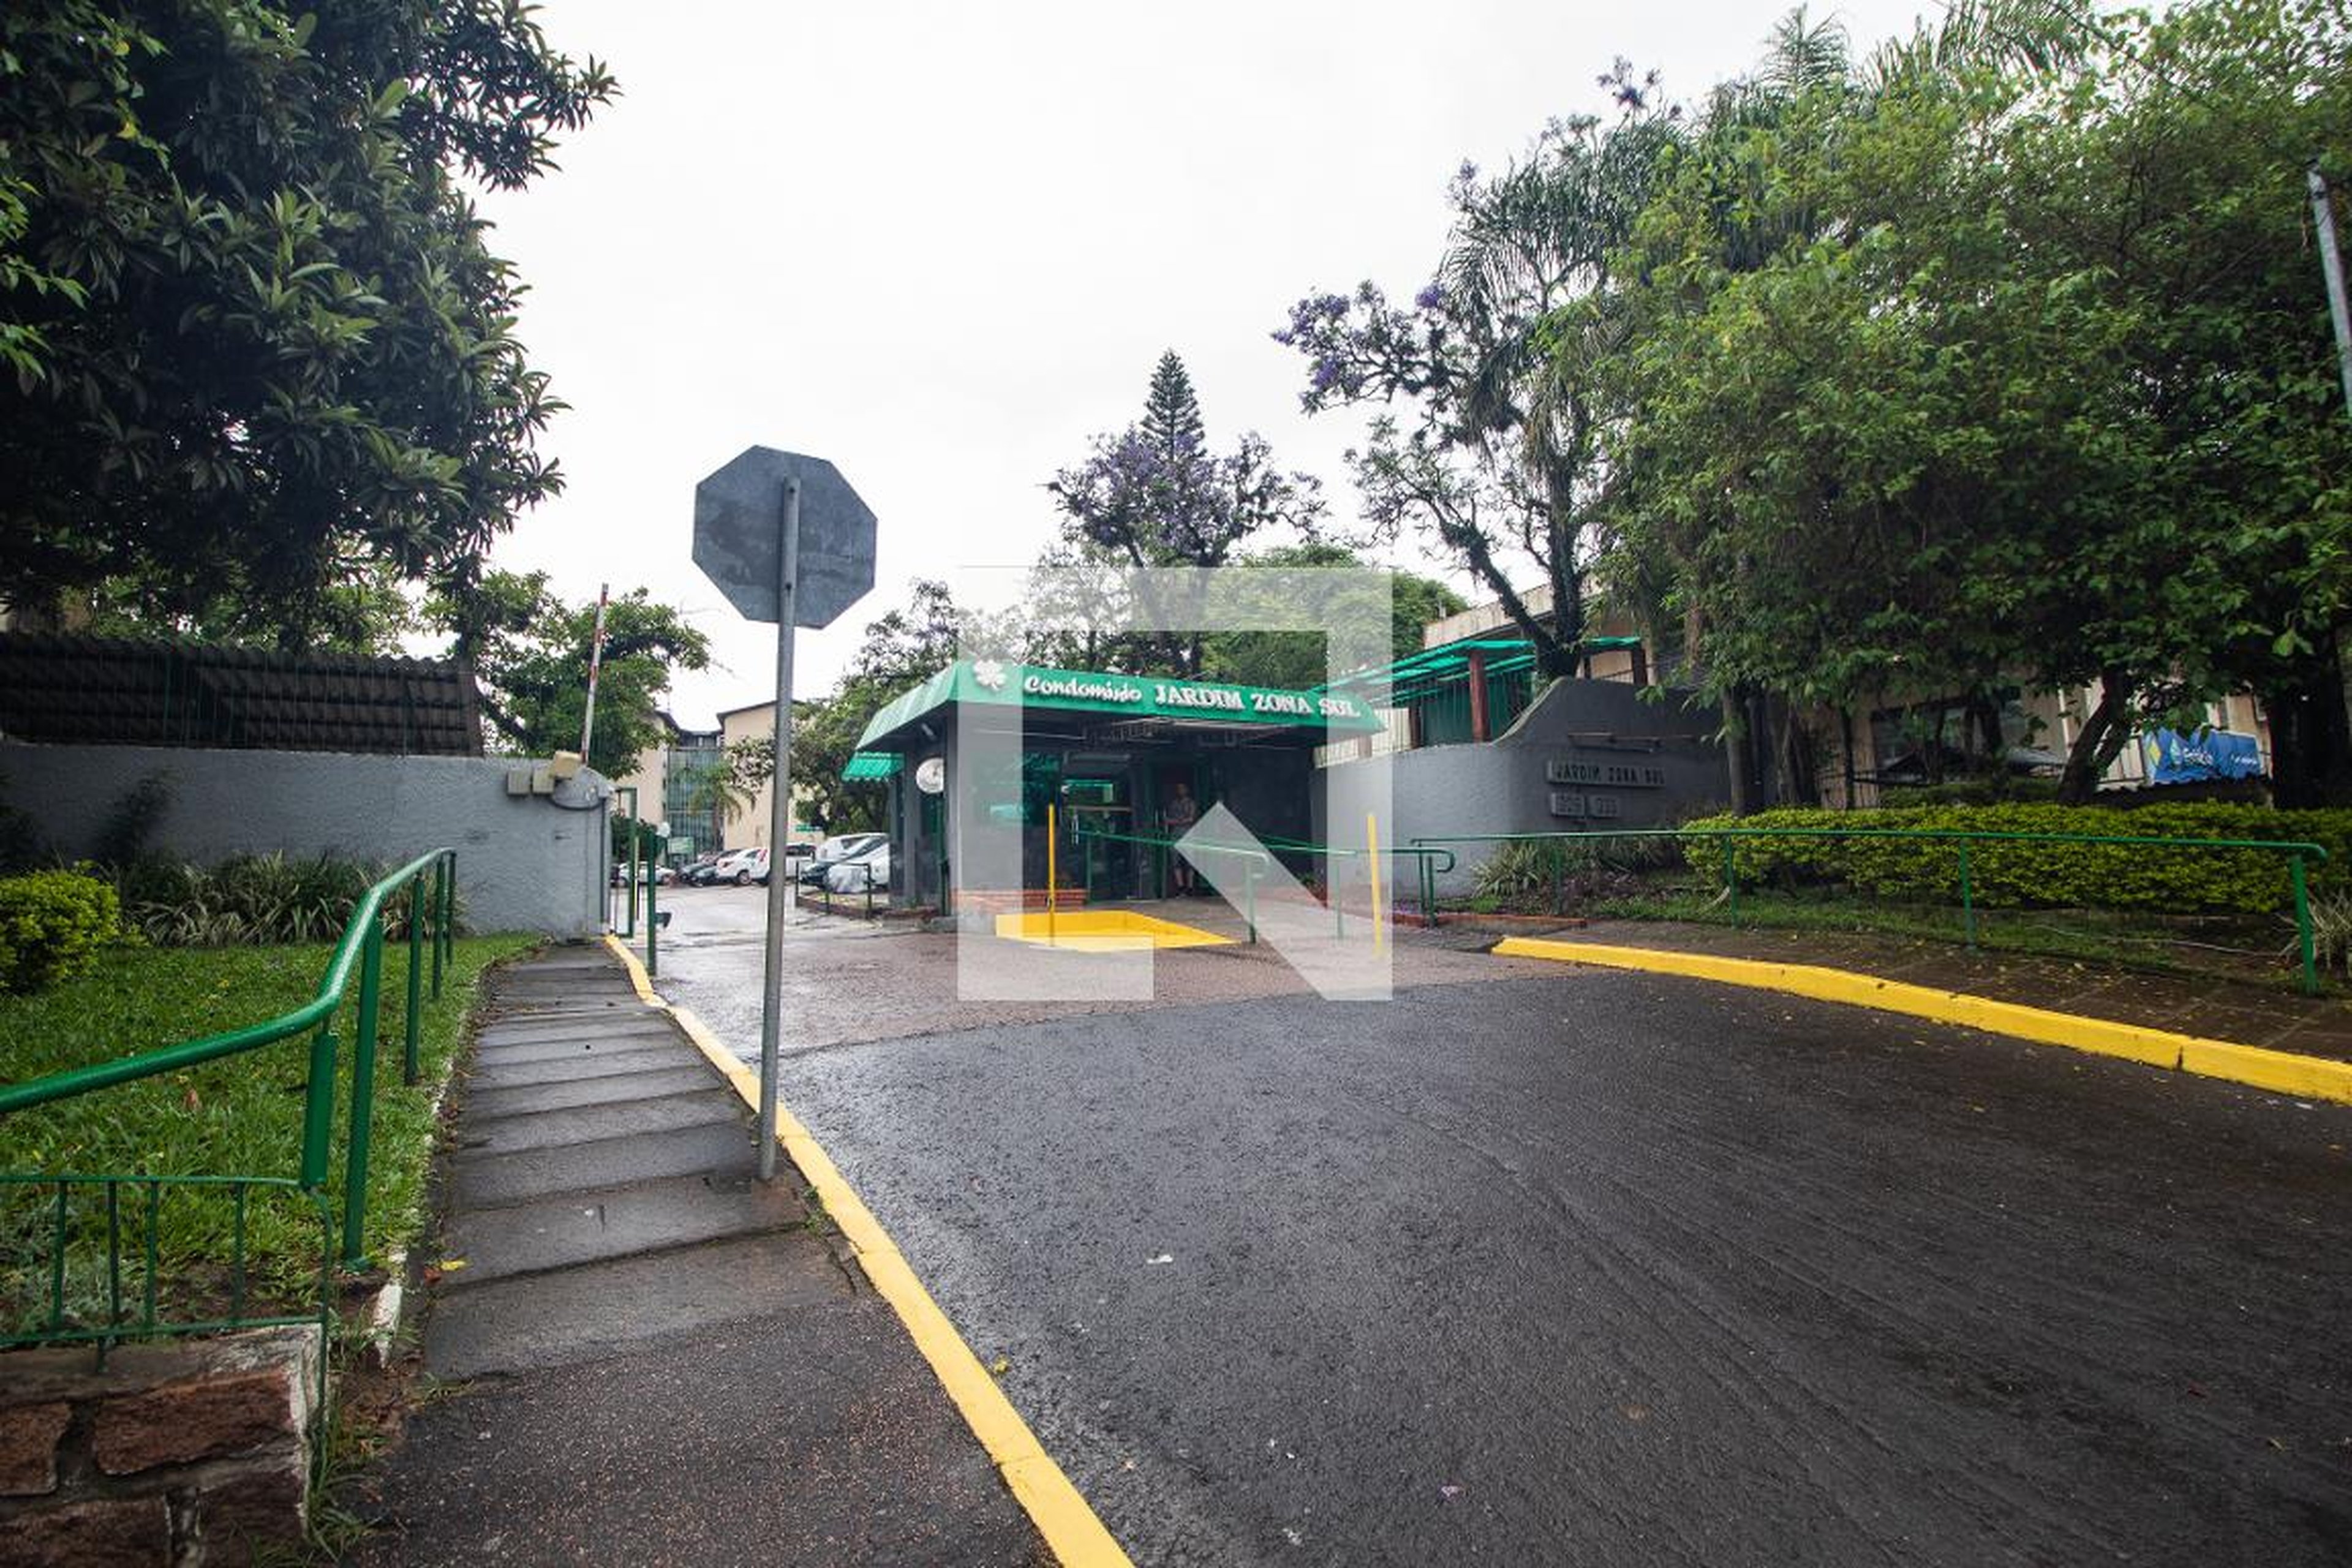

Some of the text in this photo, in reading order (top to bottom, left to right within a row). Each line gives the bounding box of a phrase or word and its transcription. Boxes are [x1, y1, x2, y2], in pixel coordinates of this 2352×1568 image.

[1155, 684, 1245, 709] JARDIM
[1250, 693, 1314, 714] ZONA
[1319, 698, 1360, 717] SUL
[1556, 763, 1601, 782] JARDIM
